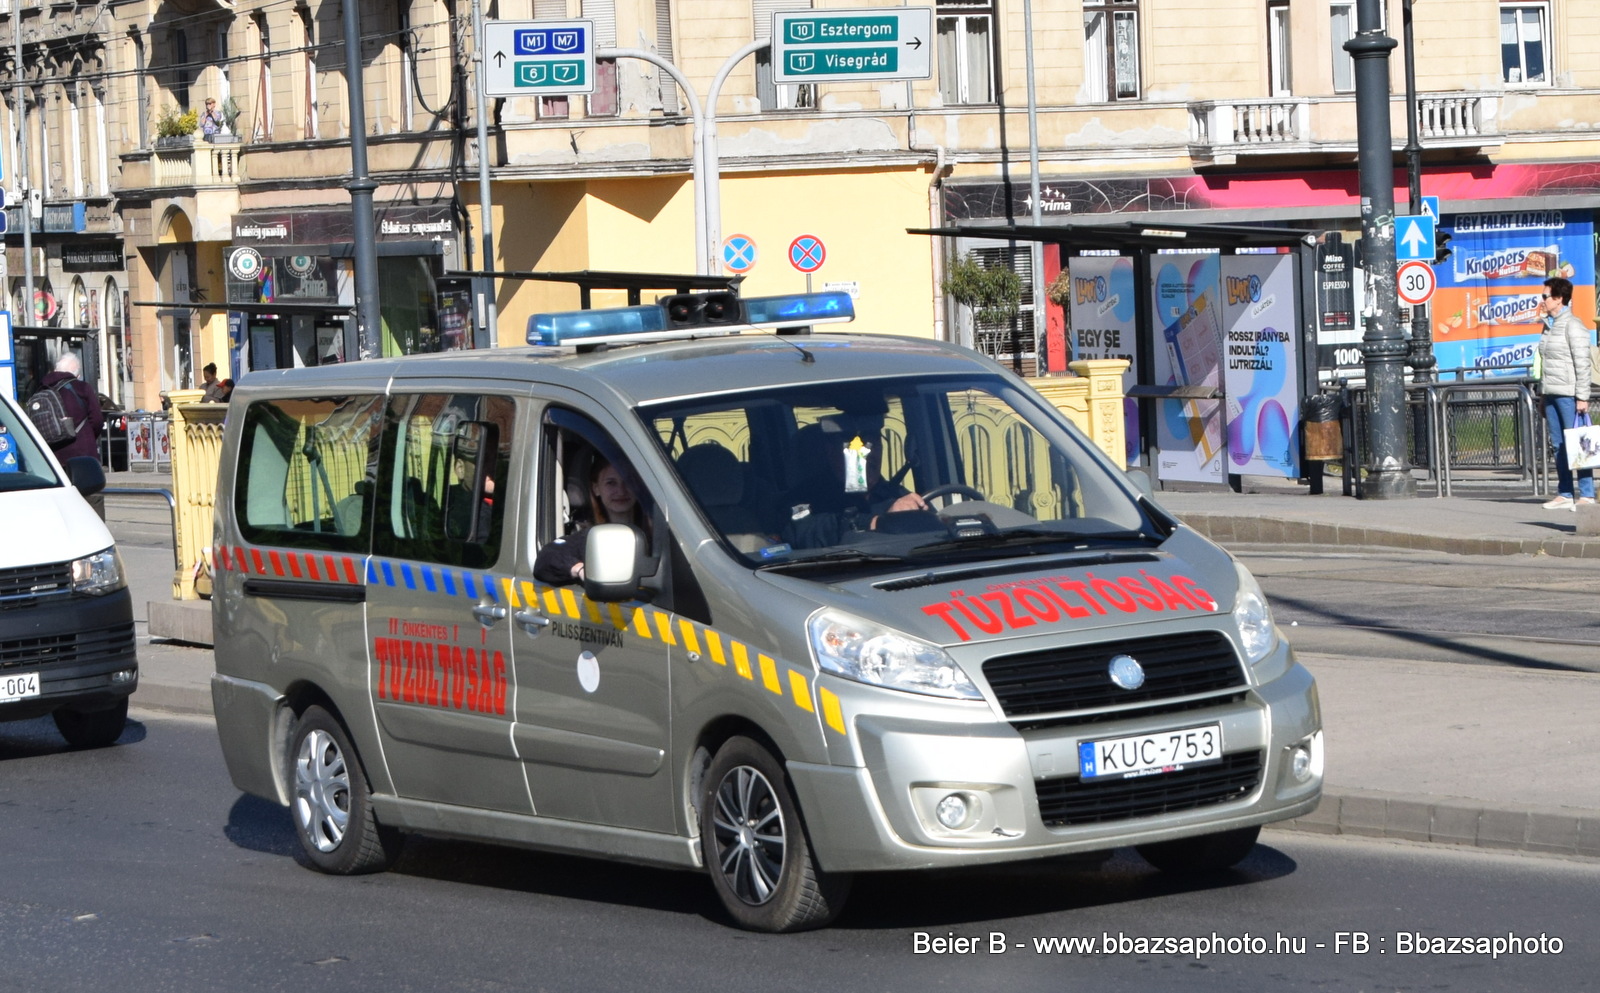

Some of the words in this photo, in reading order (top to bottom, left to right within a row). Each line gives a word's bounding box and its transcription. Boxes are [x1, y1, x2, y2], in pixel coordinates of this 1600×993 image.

[797, 25, 808, 36] 10
[820, 23, 892, 38] Esztergom
[526, 36, 541, 47] M1
[557, 35, 573, 46] M7
[798, 56, 807, 67] 11
[825, 52, 888, 70] Visegrád
[529, 68, 538, 79] 6
[562, 67, 570, 78] 7
[1040, 199, 1072, 211] Prima
[1456, 215, 1479, 231] EGY
[1480, 213, 1514, 229] FALAT
[1322, 262, 1346, 270] COFFEE
[1325, 255, 1343, 263] Mizo
[1466, 249, 1526, 276] Knoppers
[1406, 274, 1425, 292] 30
[1479, 296, 1538, 321] Knoppers
[1077, 329, 1102, 348] EGY
[1103, 329, 1121, 349] SE
[1228, 331, 1254, 342] ROSSZ
[1254, 329, 1290, 342] IRÁNYBA
[1229, 343, 1270, 356] INDULTÁL?
[1474, 344, 1533, 368] Knoppers
[1229, 357, 1273, 370] LUTRIZZÁL!
[920, 569, 1218, 642] TŰZOLTÓSÁG
[402, 619, 448, 640] ÖNKÉNTES
[551, 621, 624, 648] PILISSZENTIVÁN
[1102, 731, 1214, 770] KUC-753
[1085, 762, 1093, 772] H
